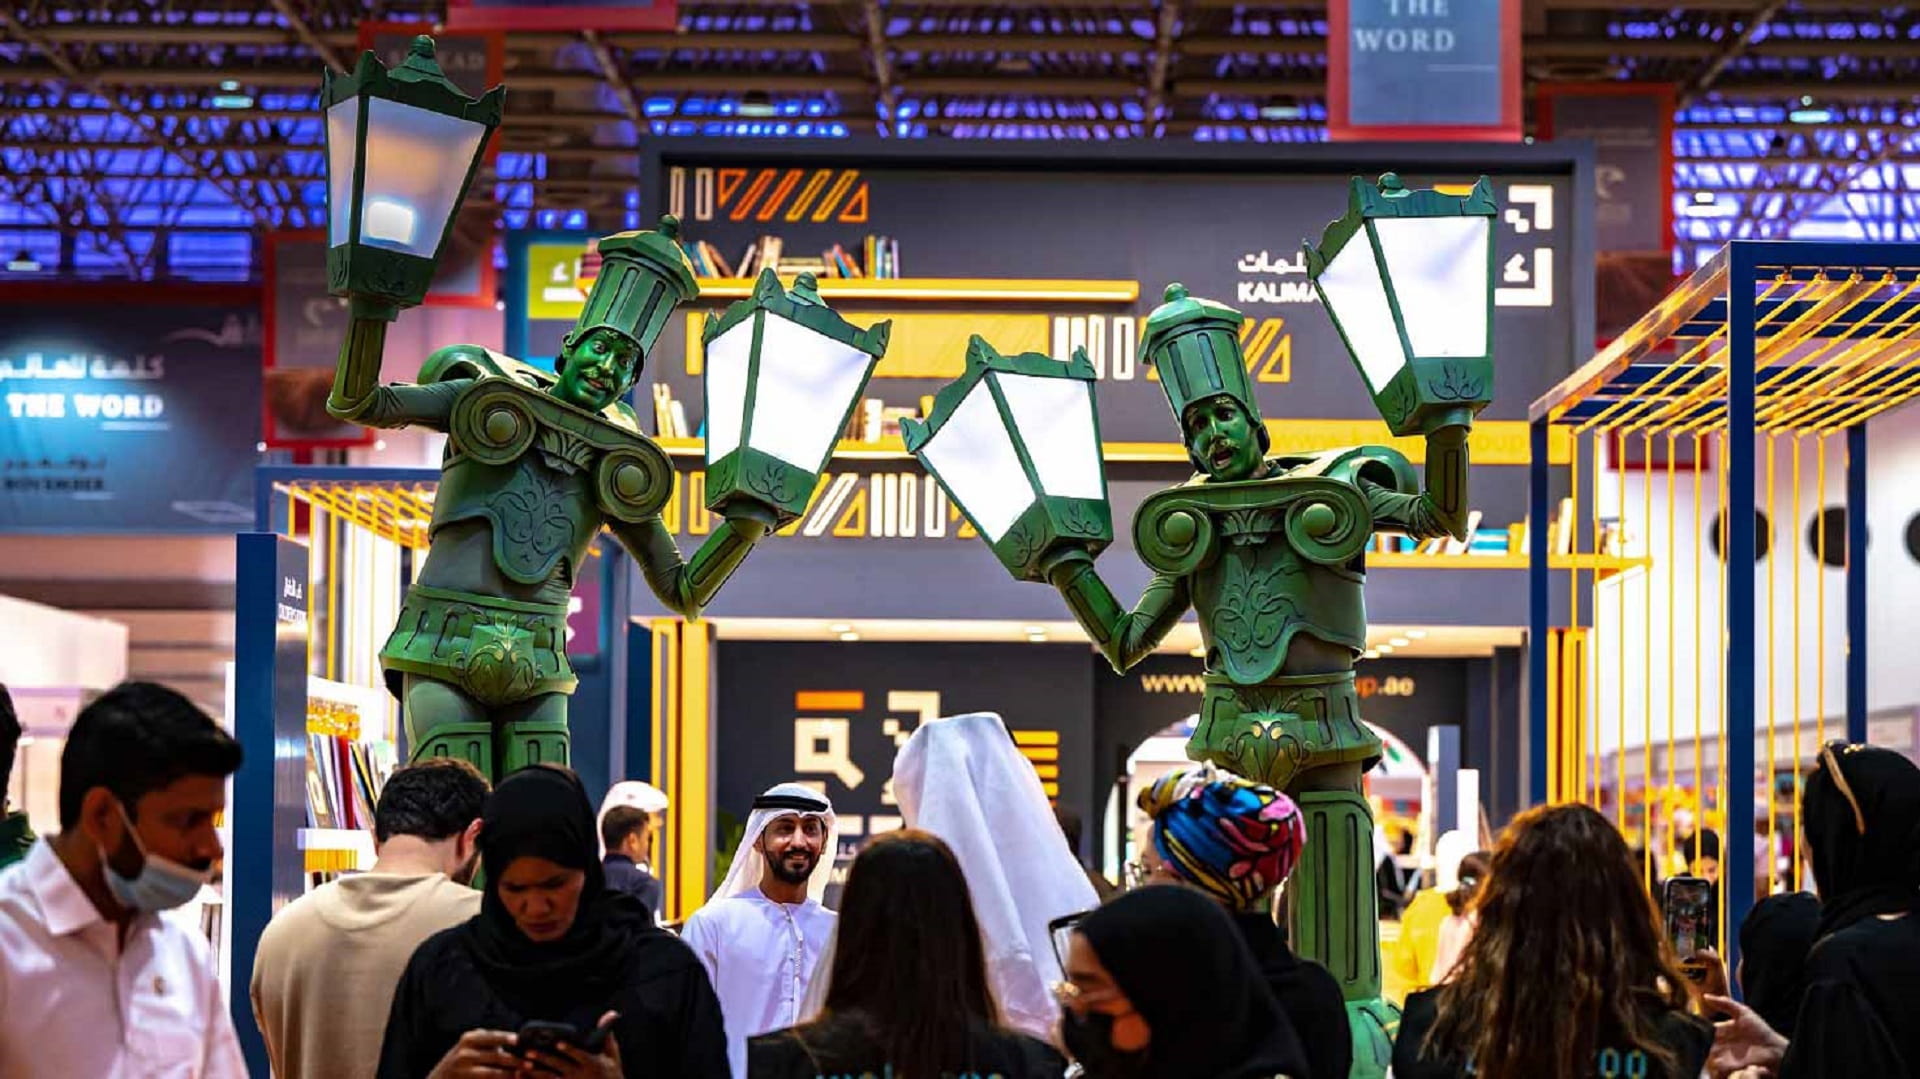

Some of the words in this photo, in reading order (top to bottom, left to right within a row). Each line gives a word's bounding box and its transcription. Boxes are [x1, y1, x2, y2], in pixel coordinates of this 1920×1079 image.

[1387, 0, 1449, 16] THE
[1354, 28, 1455, 51] WORD
[1238, 250, 1307, 275] لمات
[1237, 281, 1321, 303] KALIMA
[6, 393, 65, 418] THE
[73, 393, 164, 418] WORD
